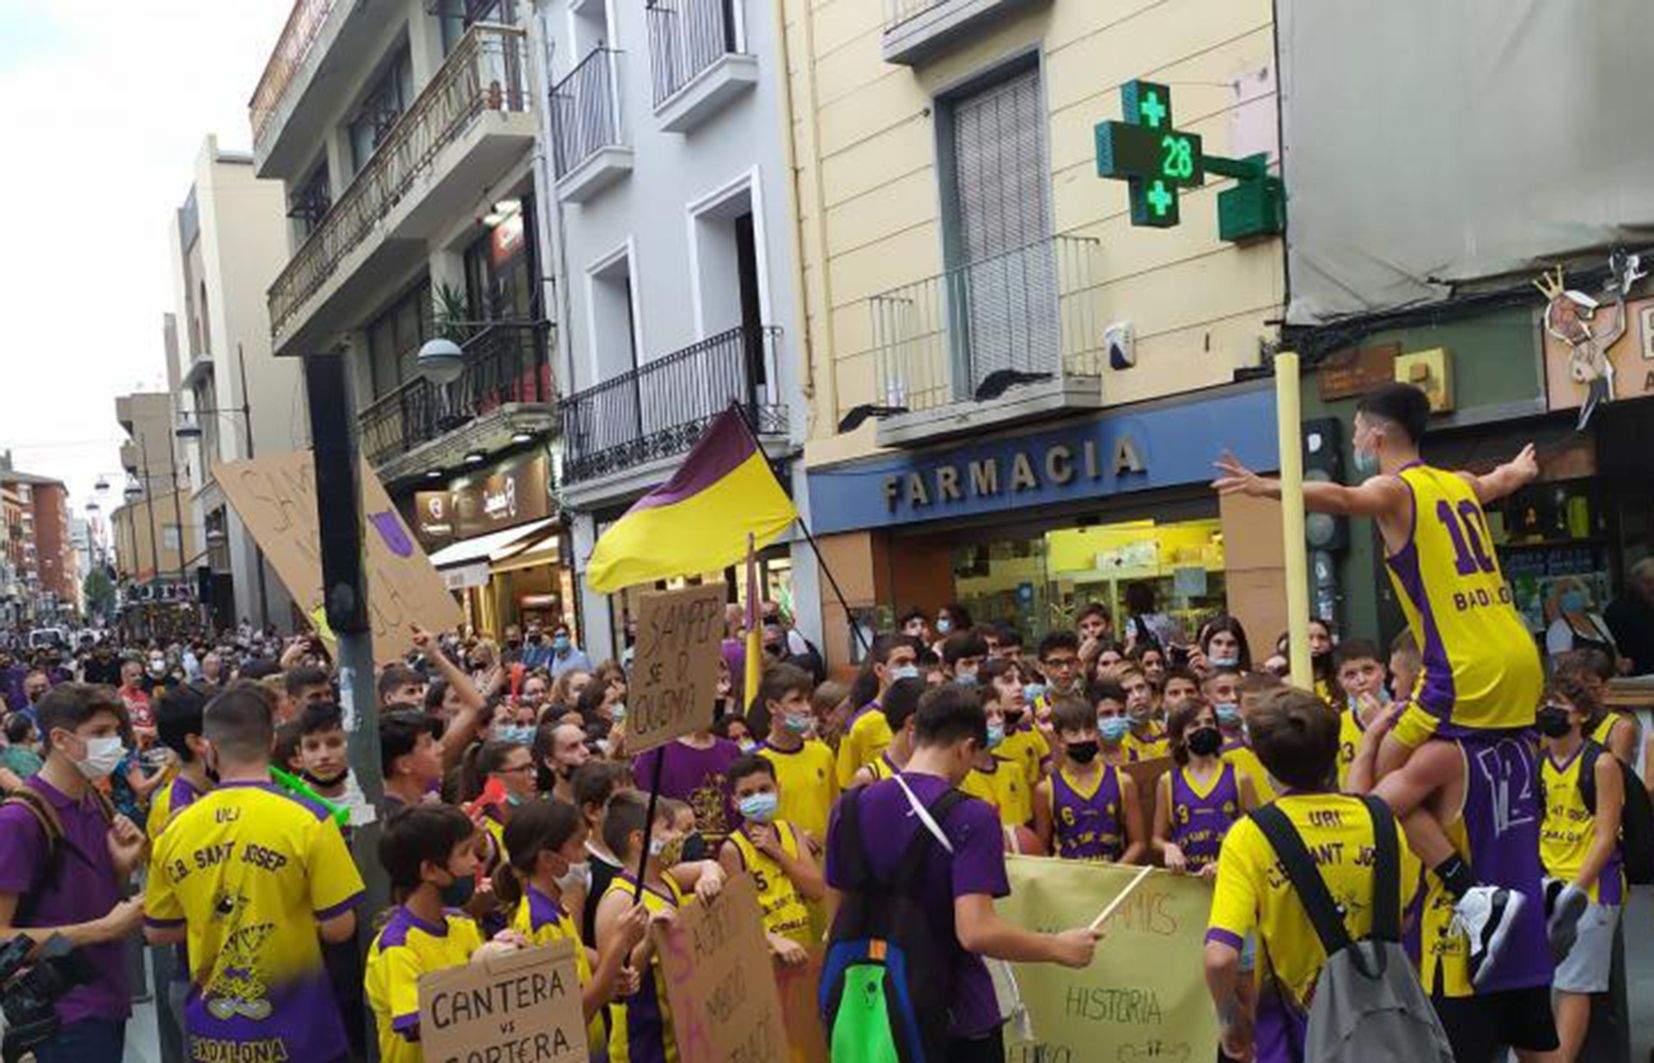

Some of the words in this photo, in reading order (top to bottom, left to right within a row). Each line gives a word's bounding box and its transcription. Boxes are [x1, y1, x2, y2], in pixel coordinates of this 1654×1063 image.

[1162, 135, 1194, 178] 28
[882, 436, 1148, 513] FARMACIA
[1436, 498, 1496, 576] 10
[240, 844, 287, 872] JOSEP
[431, 969, 566, 1029] CANTERA
